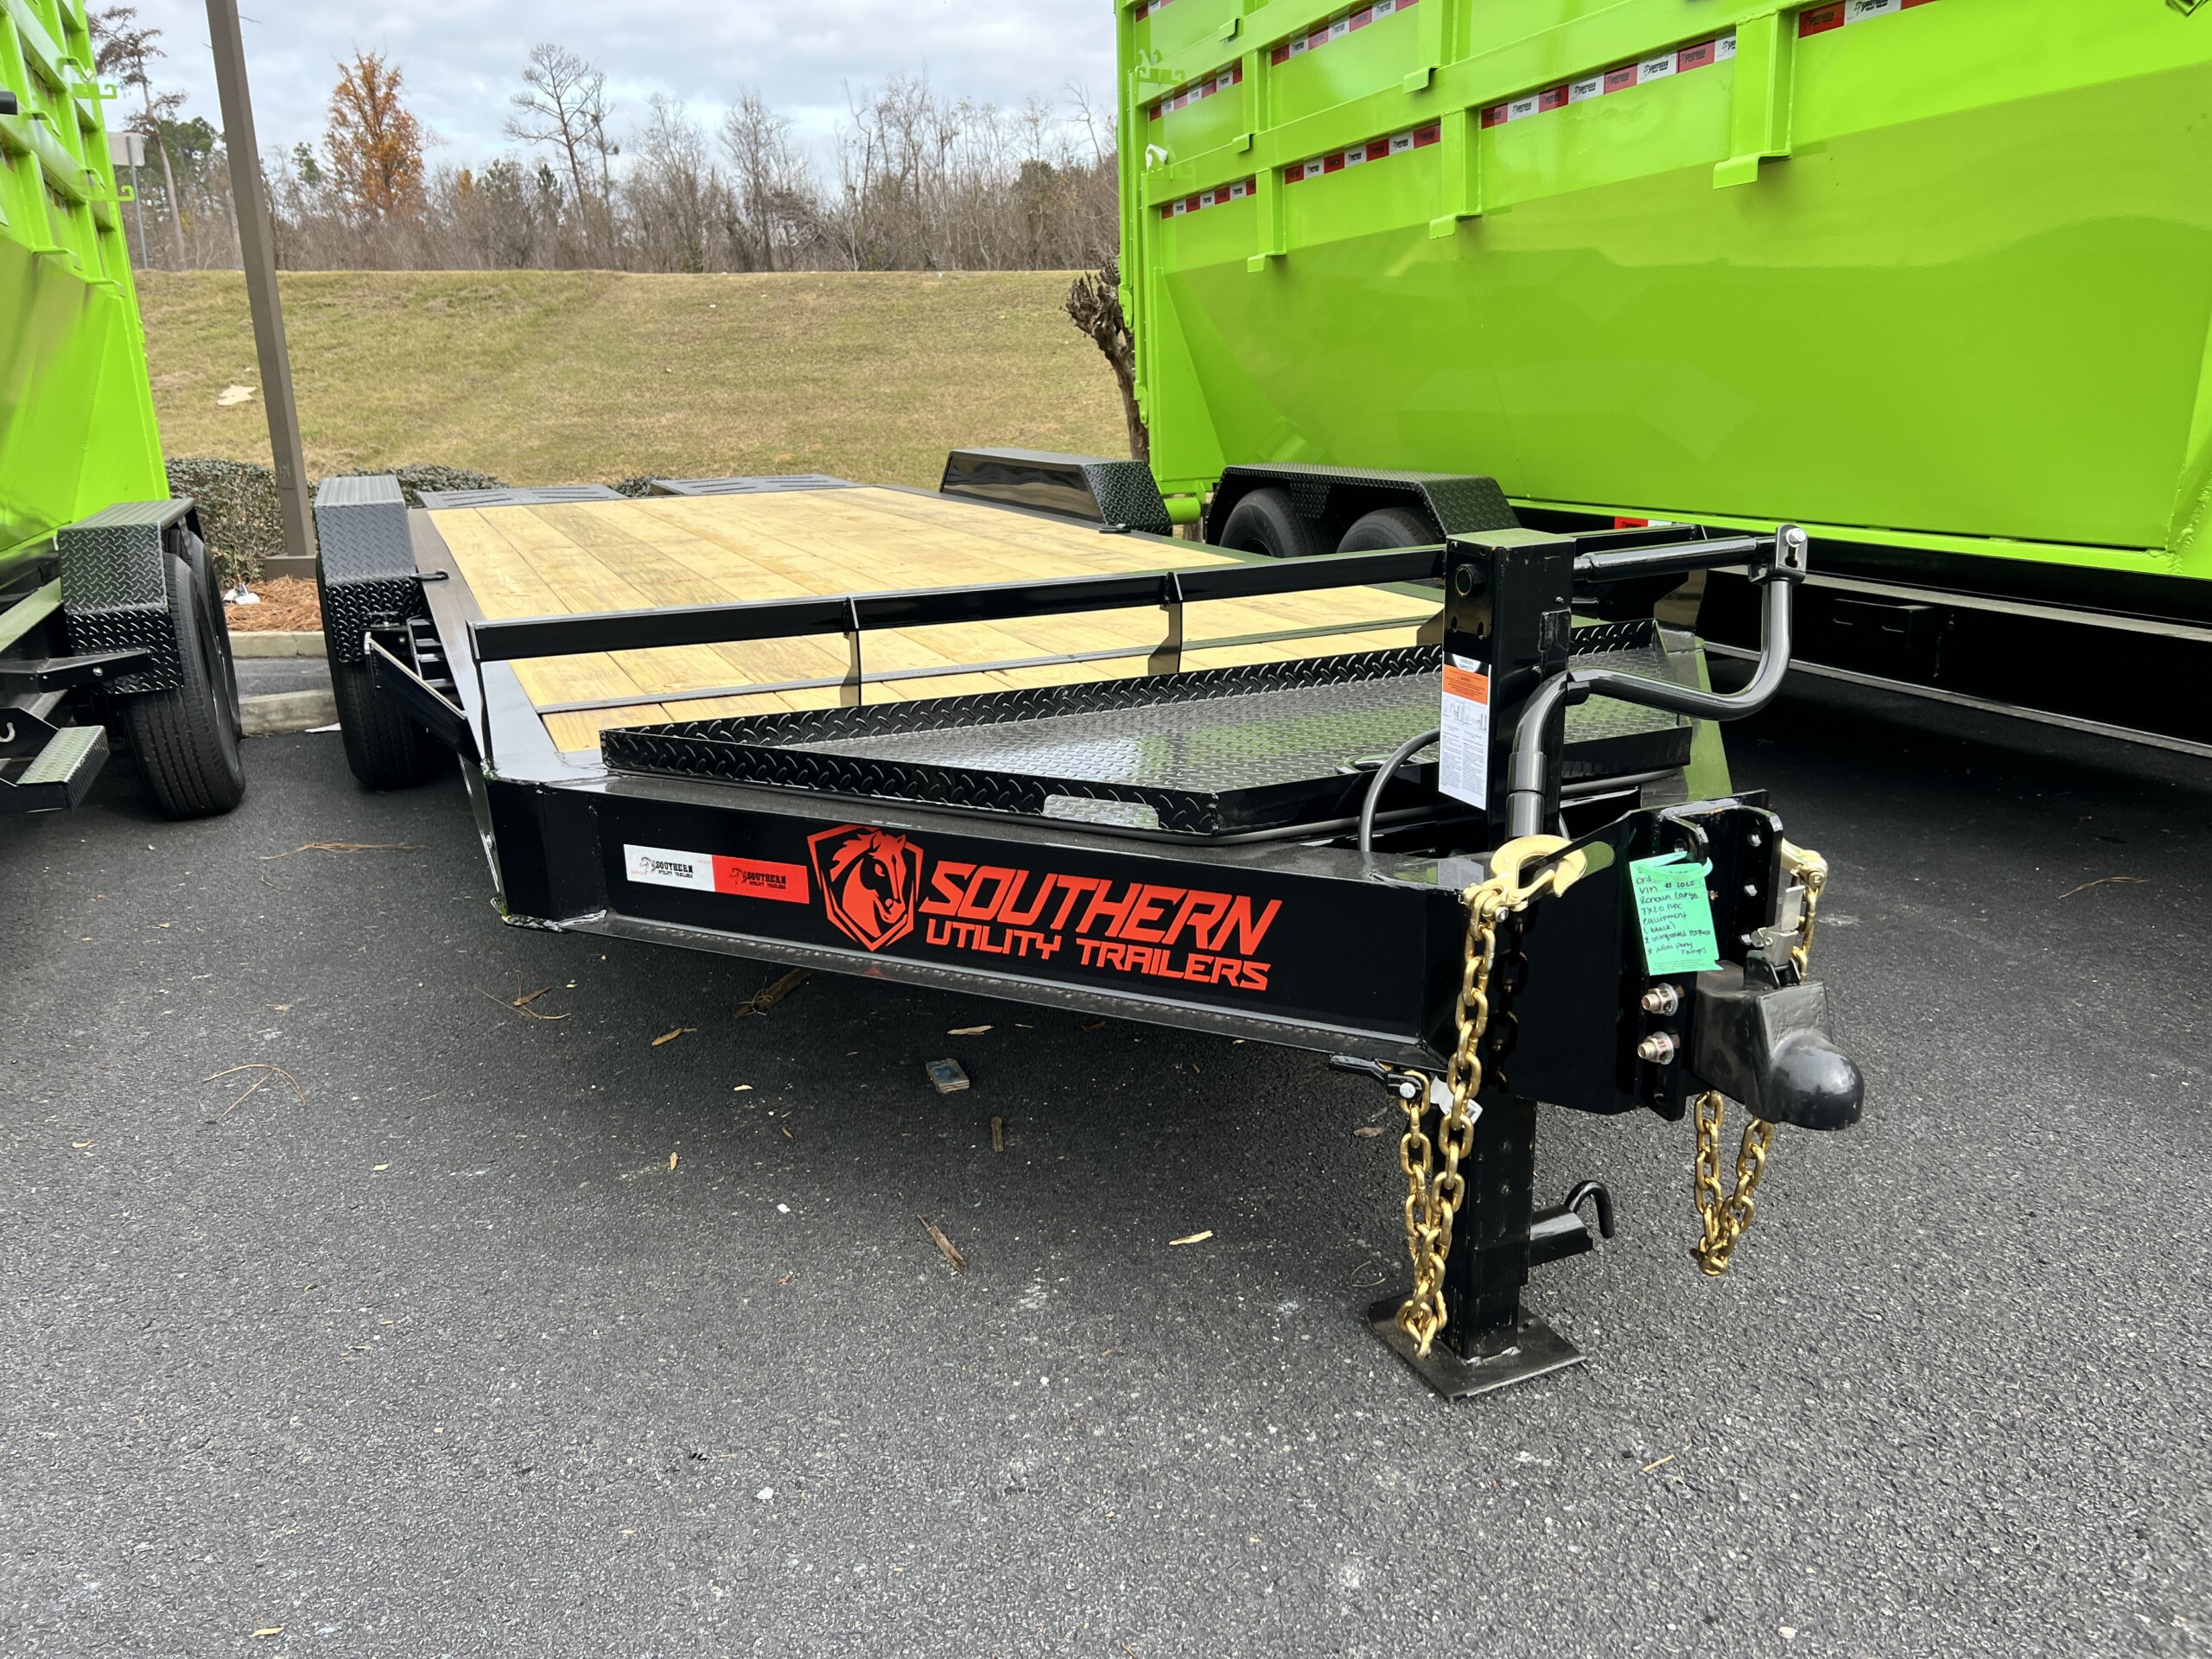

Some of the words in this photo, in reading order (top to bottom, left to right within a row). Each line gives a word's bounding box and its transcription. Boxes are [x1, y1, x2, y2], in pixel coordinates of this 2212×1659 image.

[655, 861, 693, 873] SOUTHERN
[747, 871, 786, 884] SOUTHERN
[918, 861, 1283, 956] SOUTHERN
[926, 918, 1062, 960] UTILITY
[1076, 938, 1271, 991] TRAILERS
